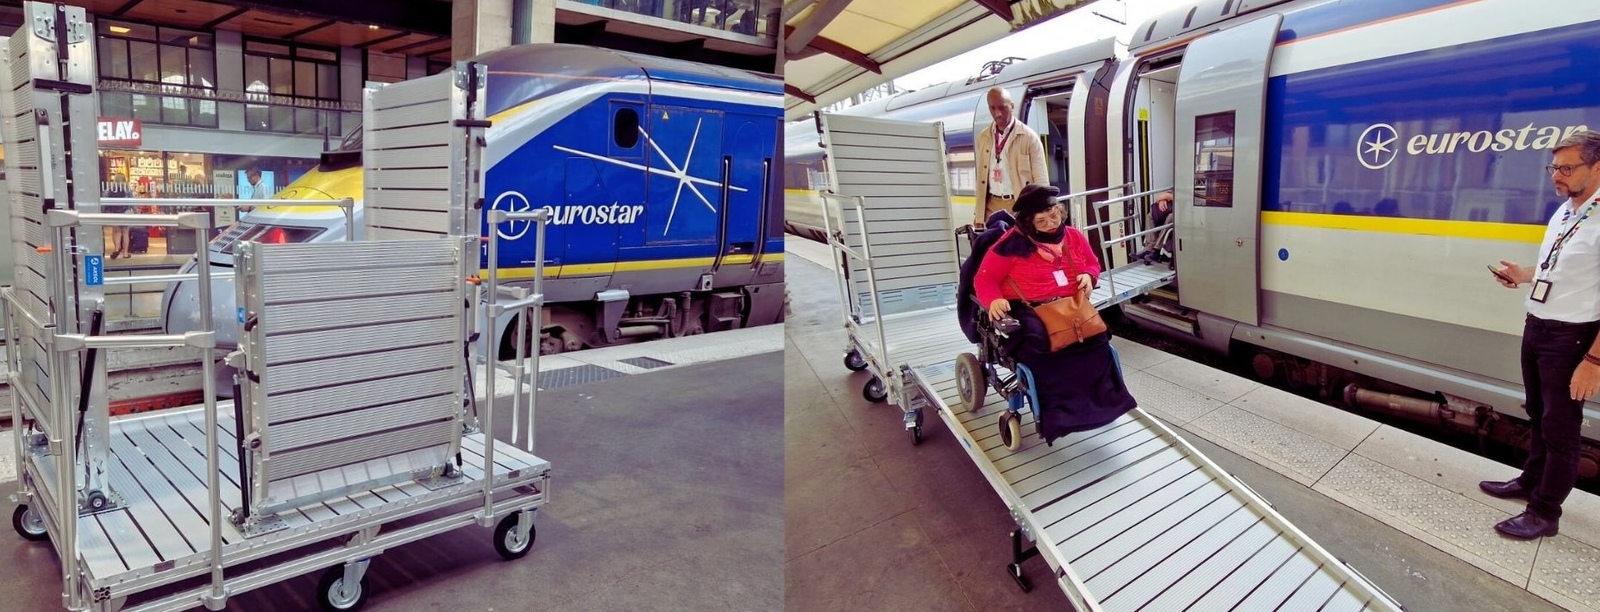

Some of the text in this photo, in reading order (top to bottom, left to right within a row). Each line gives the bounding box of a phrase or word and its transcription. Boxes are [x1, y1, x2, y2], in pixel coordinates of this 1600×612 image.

[97, 121, 134, 140] ELAY
[1407, 122, 1587, 155] eurostar
[544, 201, 643, 225] eurostar
